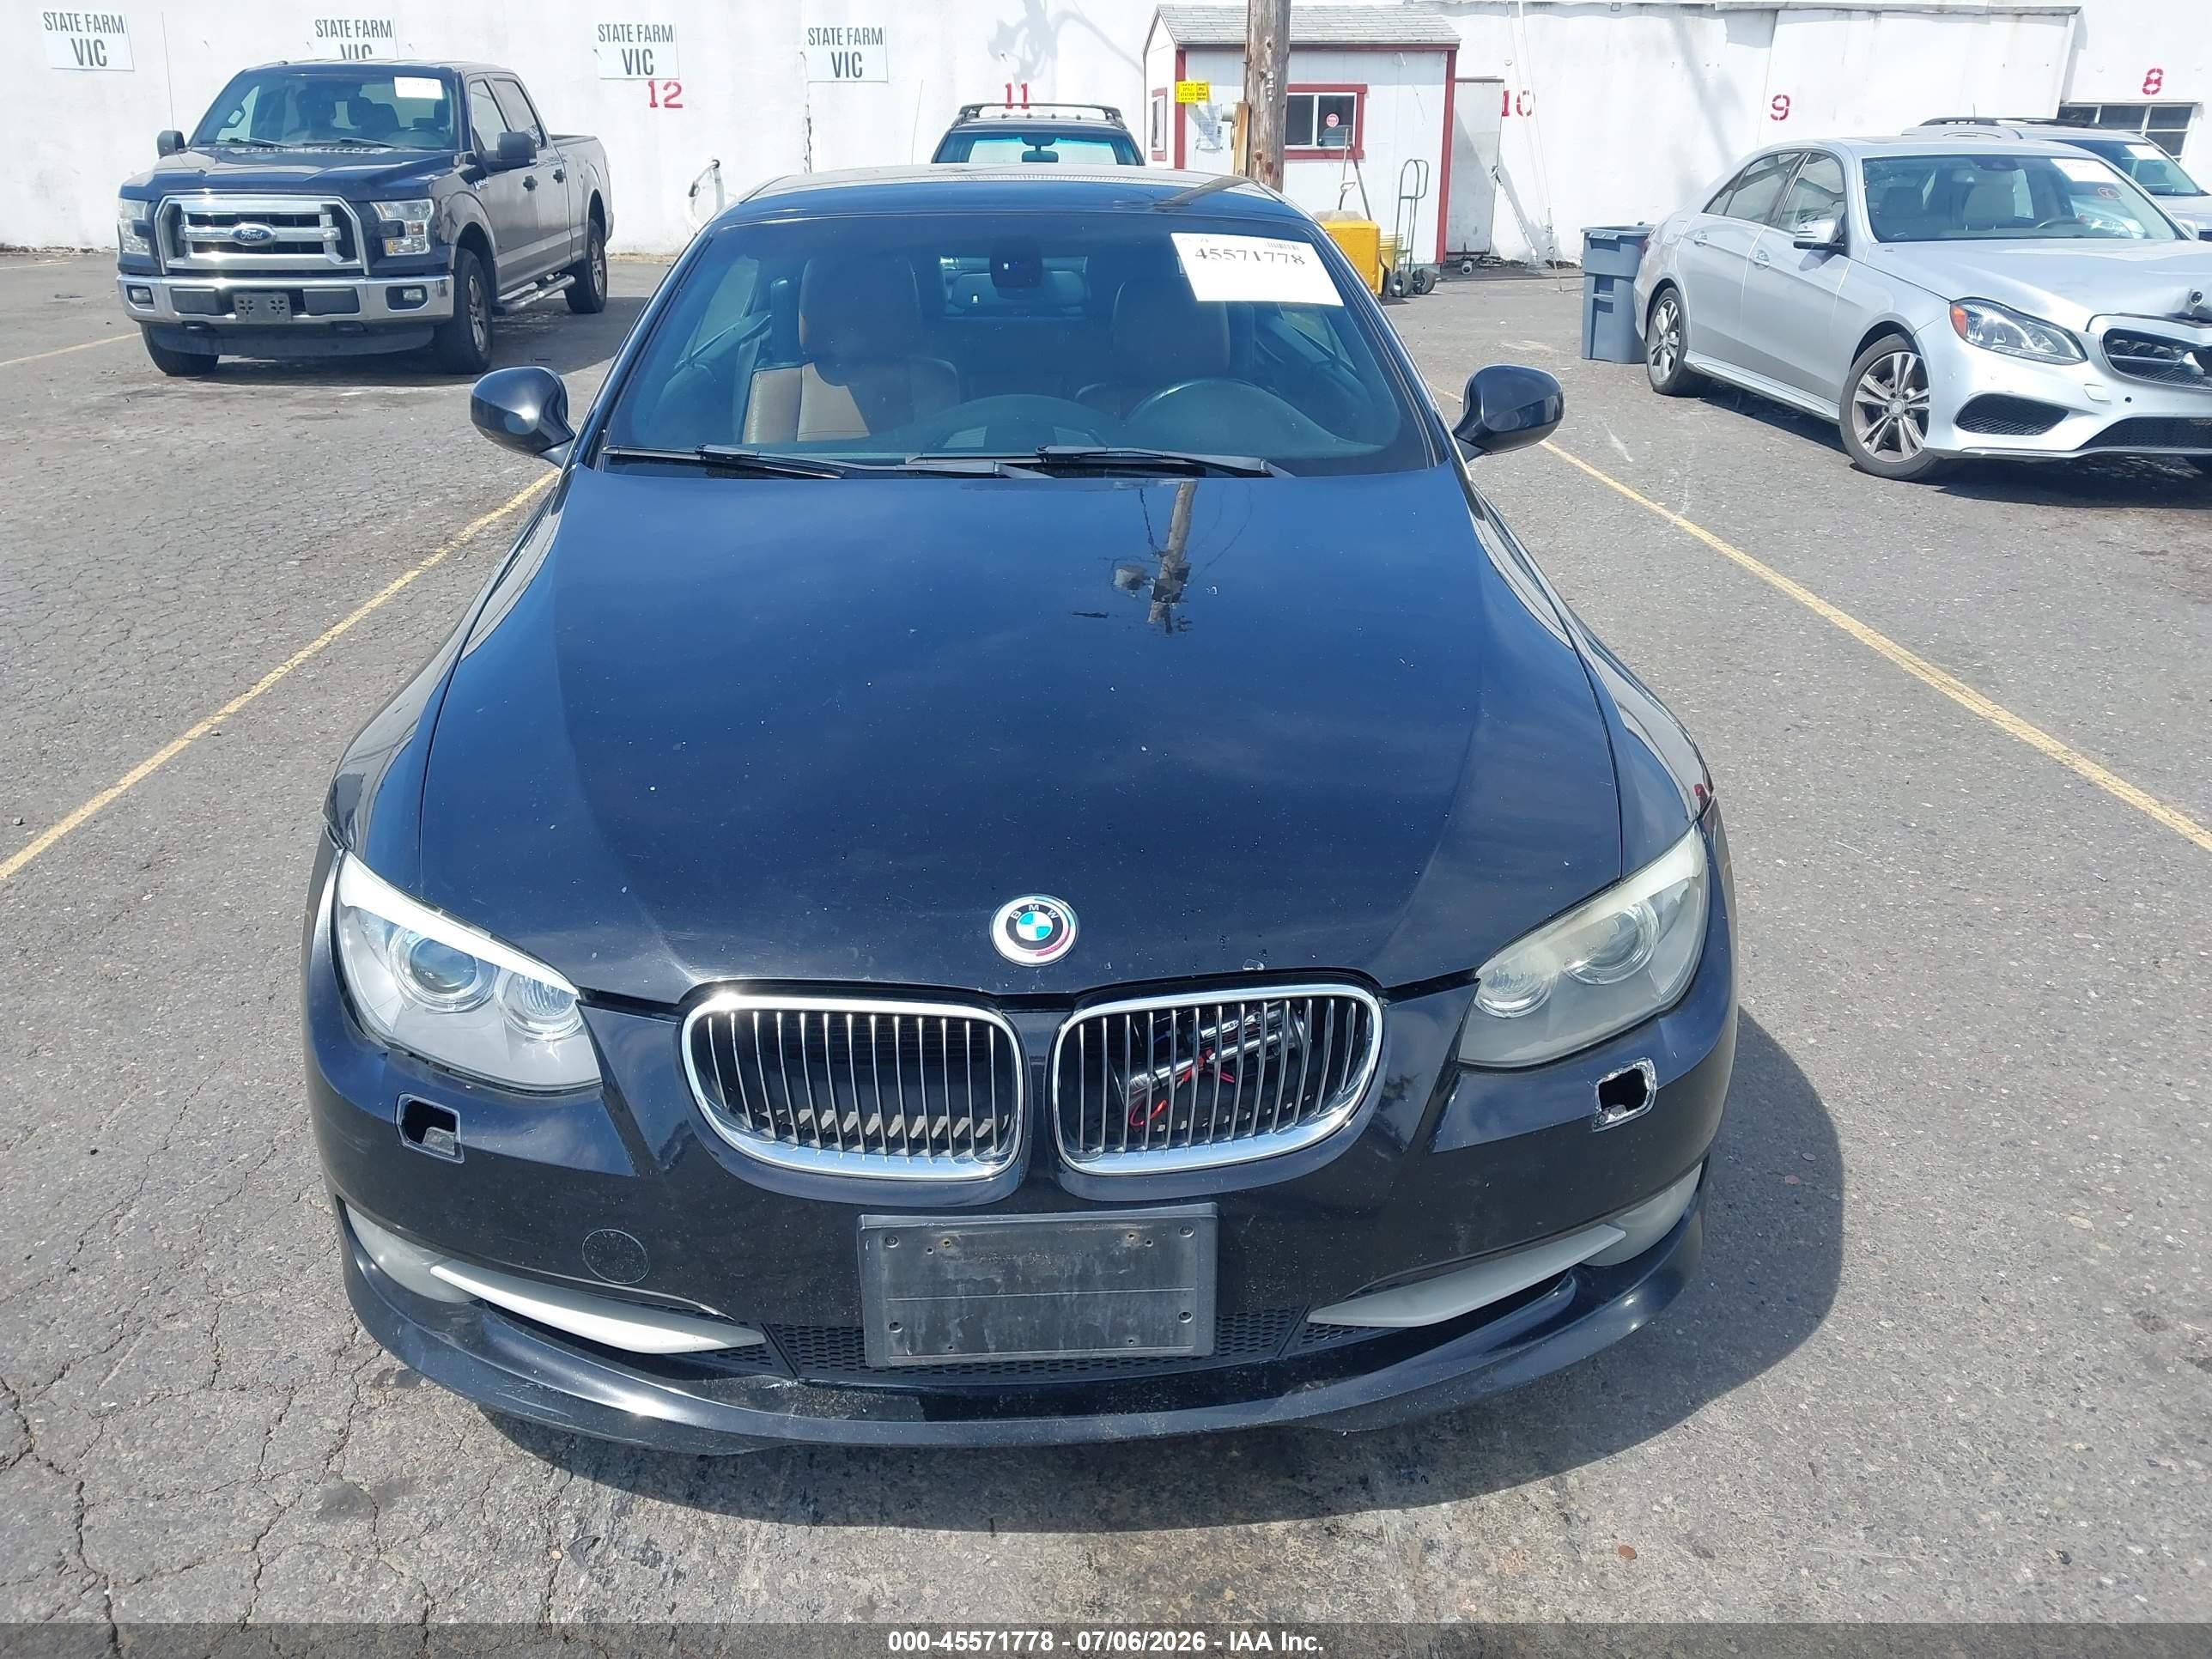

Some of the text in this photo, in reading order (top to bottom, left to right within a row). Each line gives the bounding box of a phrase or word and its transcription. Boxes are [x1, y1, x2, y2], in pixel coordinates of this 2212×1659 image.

[43, 11, 125, 34] STATE FARM
[314, 18, 392, 39] STATE FARM
[598, 23, 673, 43] STATE FARM
[808, 27, 883, 46] STATE FARM
[70, 37, 107, 67] VIC
[621, 48, 654, 76] VIC
[830, 51, 863, 78] VIC
[647, 80, 684, 108] 12
[2142, 68, 2164, 95] 8
[1005, 82, 1030, 110] 11
[1502, 89, 1536, 117] 10
[1770, 94, 1790, 121] 9
[240, 229, 264, 240] Ford
[1194, 247, 1306, 265] 45571778
[1010, 904, 1060, 921] BMW
